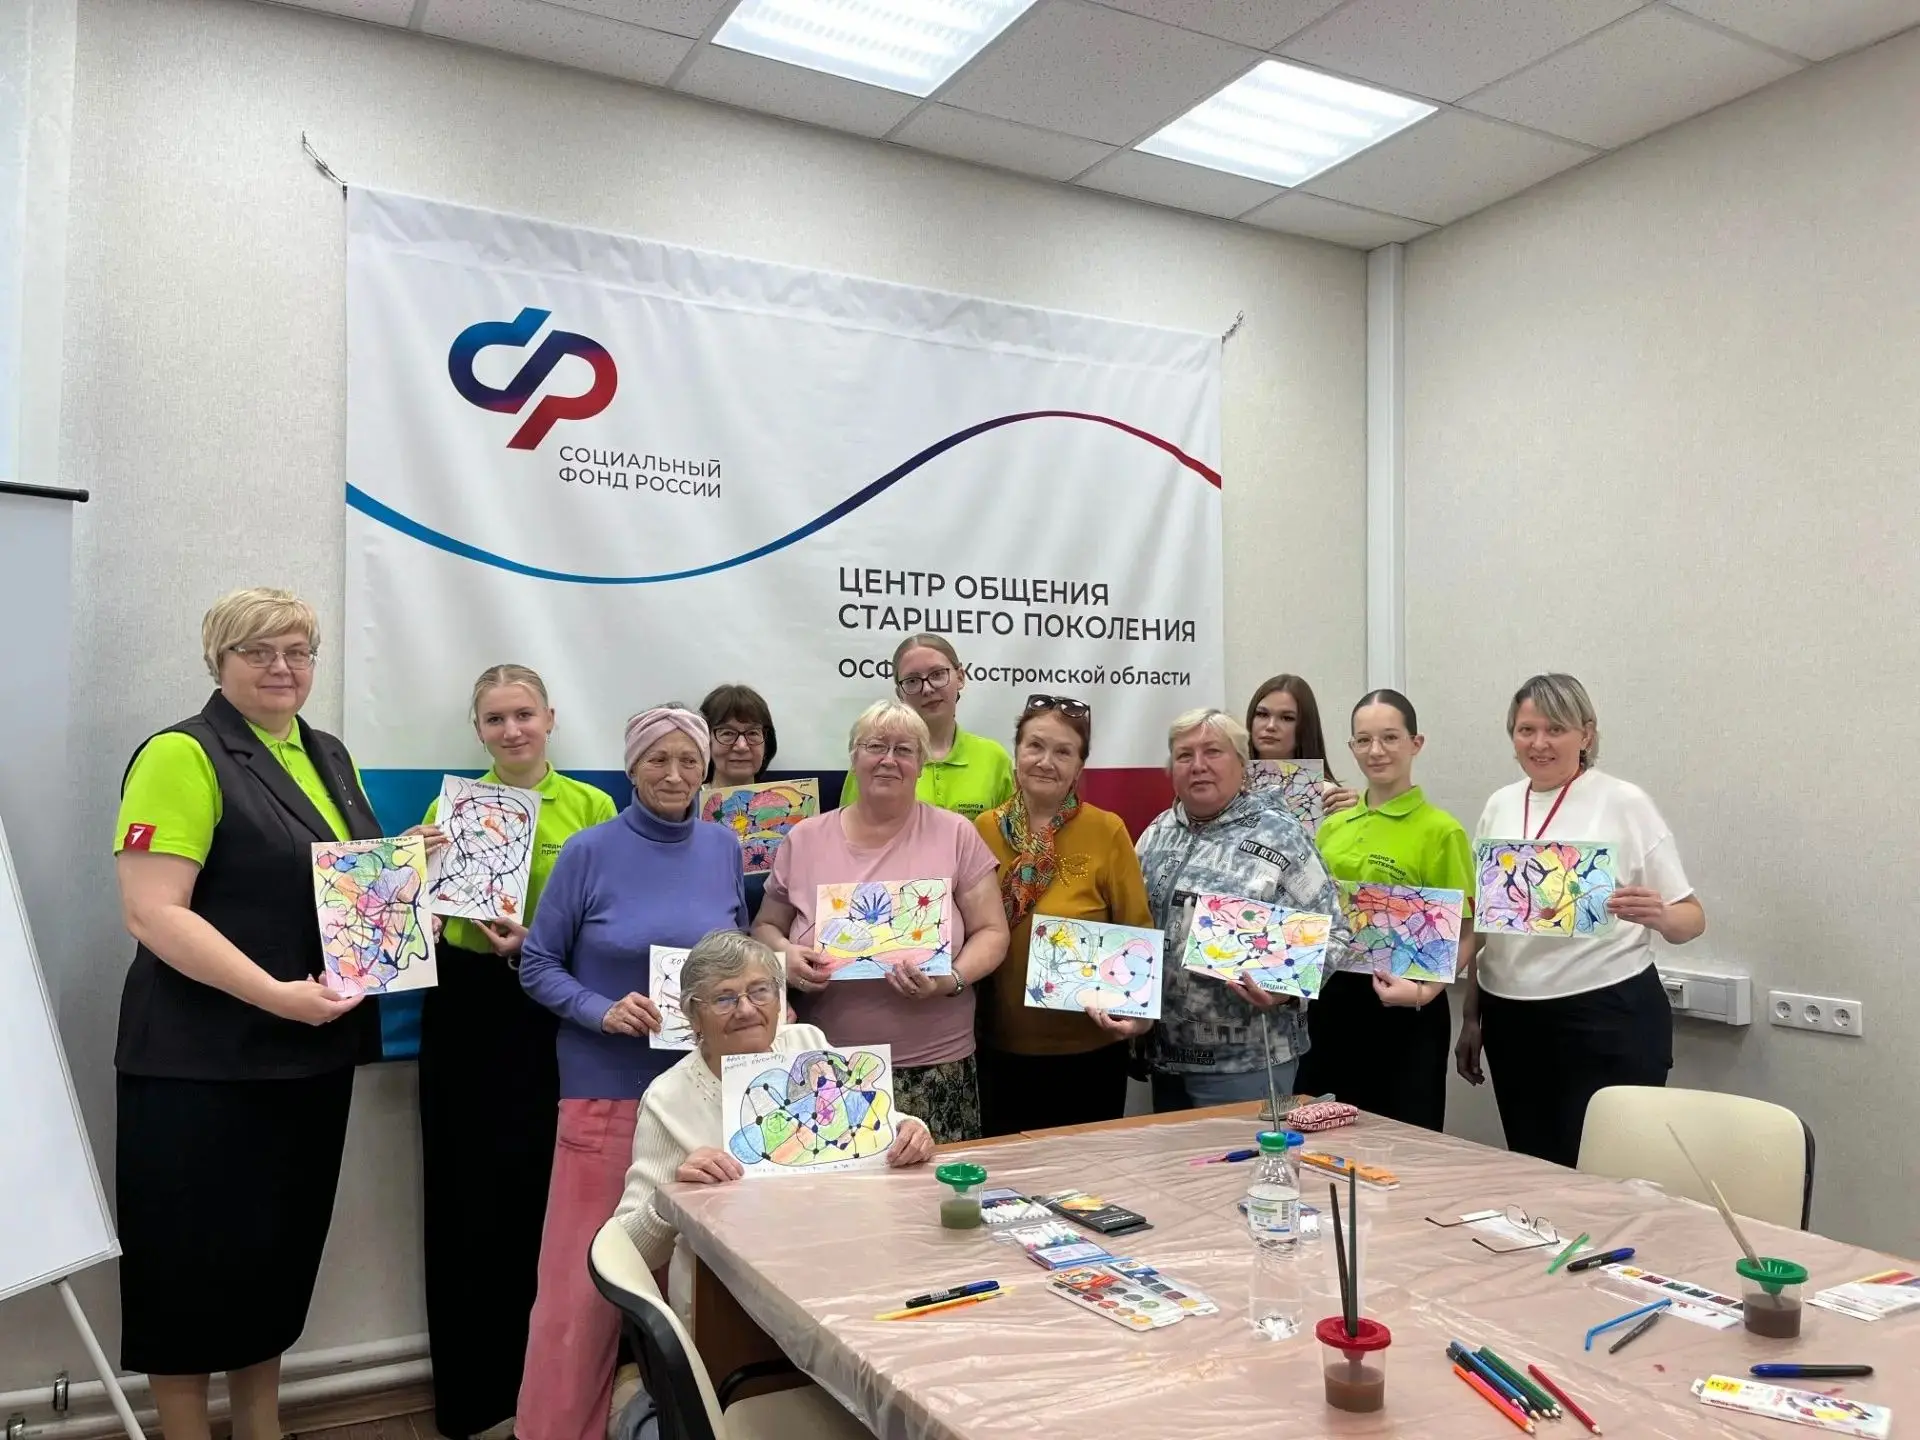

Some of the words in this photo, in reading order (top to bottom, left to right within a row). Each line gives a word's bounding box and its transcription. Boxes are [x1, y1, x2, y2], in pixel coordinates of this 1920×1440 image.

[559, 445, 721, 479] СОЦИАЛЬНЫЙ
[559, 466, 628, 490] ФОНД
[635, 474, 721, 498] РОССИИ
[839, 566, 946, 597] ЦЕНТР
[954, 575, 1109, 607] ОБЩЕНИЯ
[838, 603, 1014, 635] СТАРШЕГО
[1024, 612, 1195, 643] ПОКОЛЕНИЯ
[838, 658, 894, 680] ОСФ
[1110, 665, 1190, 686] области
[1240, 840, 1259, 854] NOT
